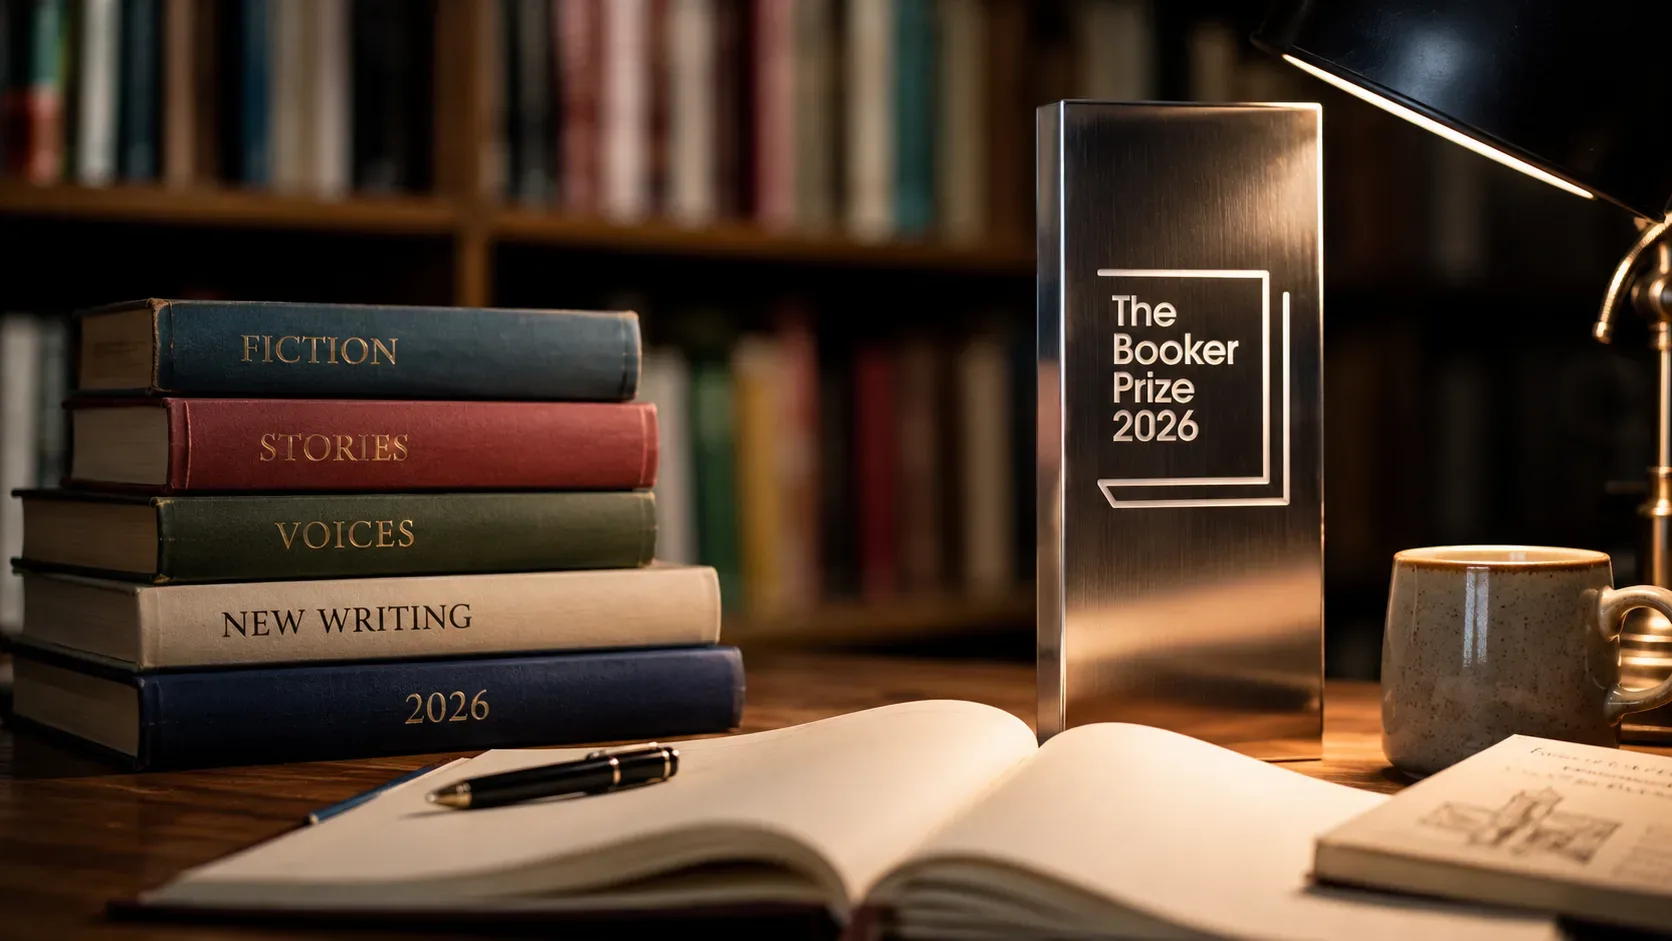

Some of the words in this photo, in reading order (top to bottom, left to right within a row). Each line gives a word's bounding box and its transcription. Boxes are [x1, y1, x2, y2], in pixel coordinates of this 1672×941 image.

[1111, 294, 1177, 327] The
[241, 334, 399, 366] FICTION
[1113, 332, 1239, 365] Booker
[1113, 371, 1195, 404] Prize
[1112, 409, 1199, 442] 2026
[259, 432, 410, 463] STORIES
[275, 518, 416, 550] VOICES
[222, 609, 305, 638] NEW
[316, 602, 473, 634] WRITING
[404, 688, 491, 726] 2026
